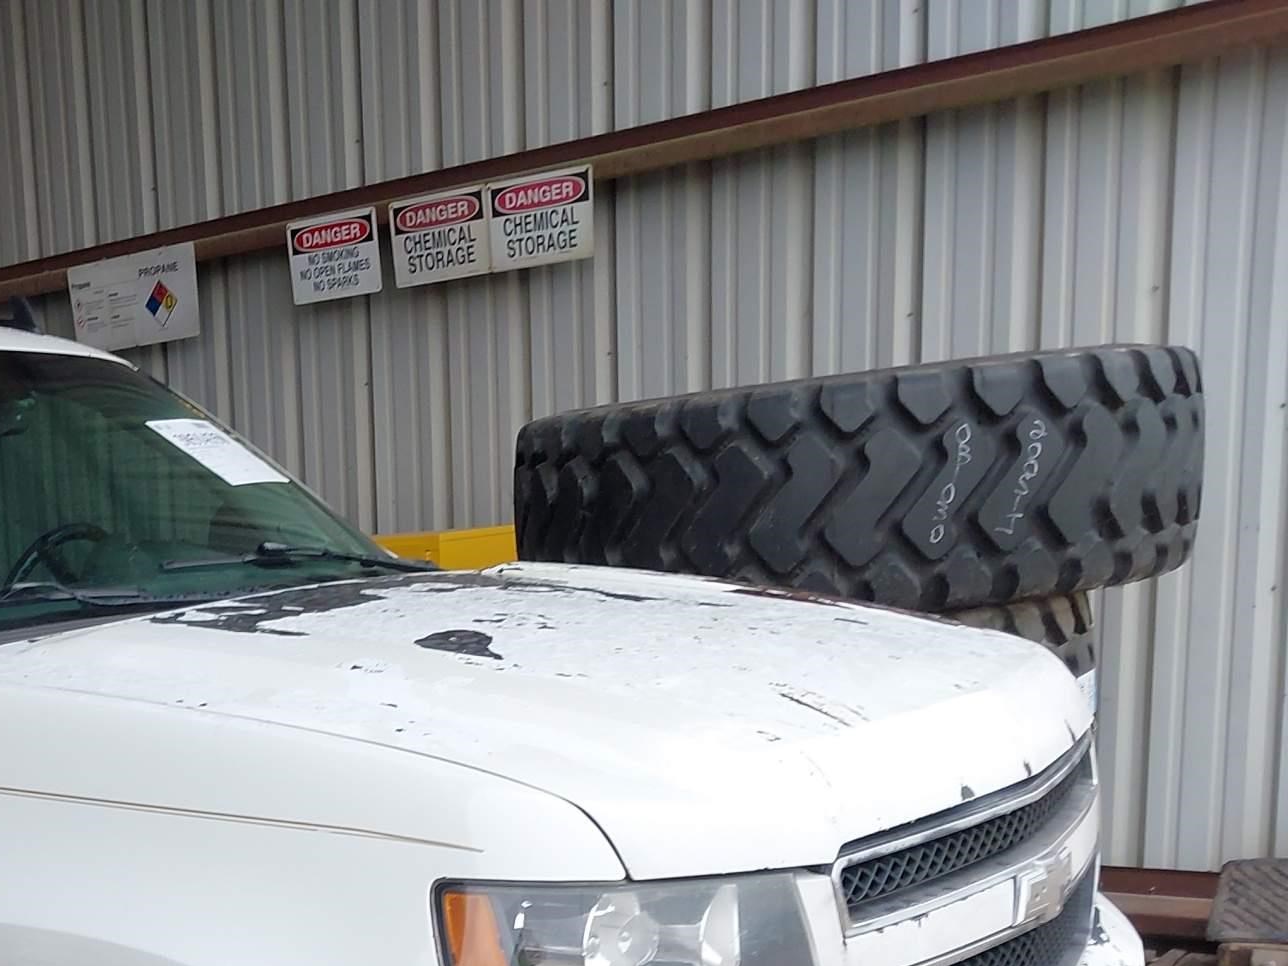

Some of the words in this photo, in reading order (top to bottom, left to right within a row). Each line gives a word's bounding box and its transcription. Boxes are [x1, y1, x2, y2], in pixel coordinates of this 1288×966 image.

[505, 182, 574, 209] DANGER
[405, 201, 469, 227] DANGER
[503, 206, 580, 236] CHEMICAL
[302, 223, 362, 248] DANGER
[403, 224, 477, 254] CHEMICAL
[507, 229, 578, 258] STORAGE
[138, 261, 180, 277] PROPANE
[300, 267, 312, 281] NO
[313, 265, 336, 280] OPEN
[337, 257, 371, 275] FLAMES
[308, 253, 321, 266] NO
[321, 246, 360, 264] SMOKING
[407, 245, 477, 274] STORAGE
[313, 280, 325, 292] NO
[326, 273, 360, 290] SPARKS
